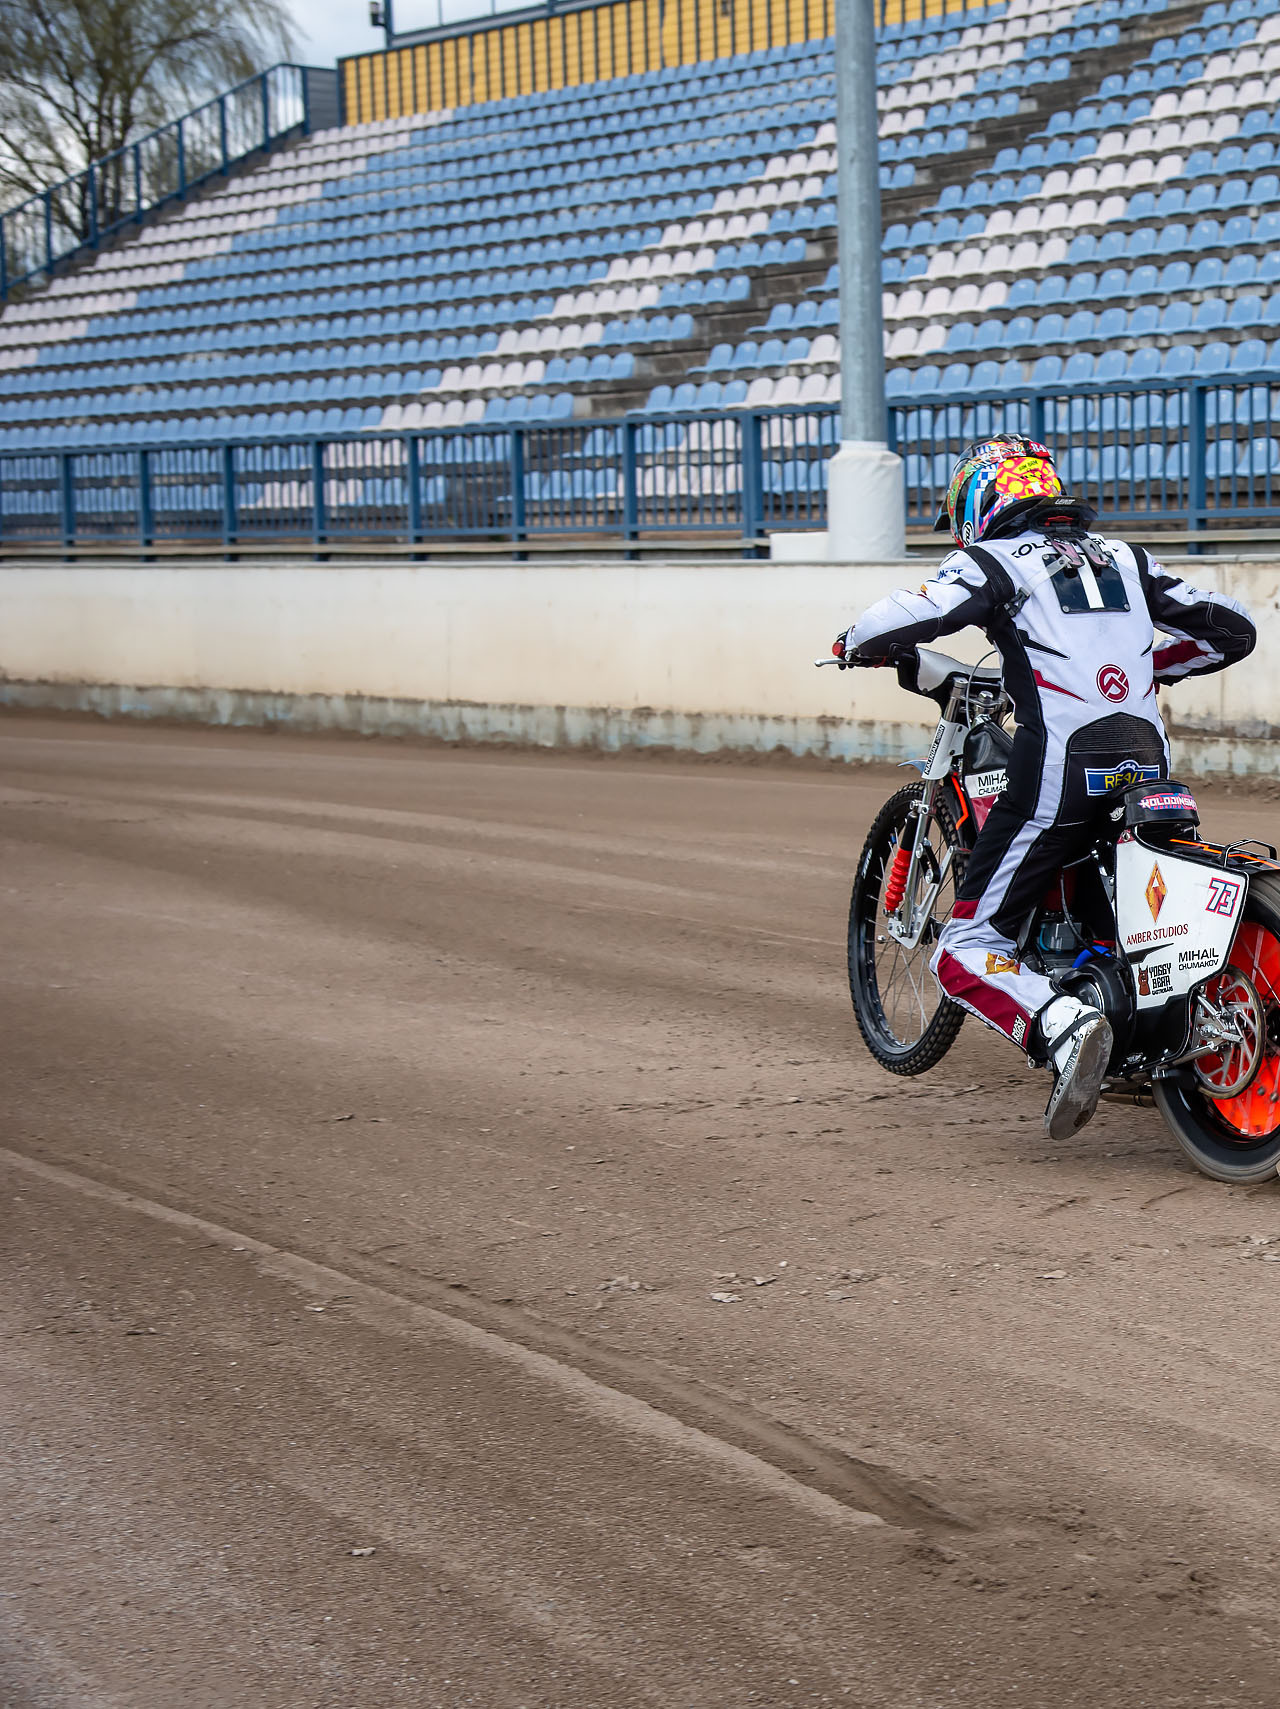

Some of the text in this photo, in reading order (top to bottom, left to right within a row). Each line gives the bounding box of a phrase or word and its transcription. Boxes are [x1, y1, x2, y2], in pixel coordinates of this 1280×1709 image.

[978, 772, 1008, 787] MIHA
[1205, 877, 1241, 918] 73
[1126, 923, 1189, 946] AMBER STUDIOS
[1178, 948, 1219, 963] MIHAIL
[1178, 959, 1219, 971] CHUMAKOV
